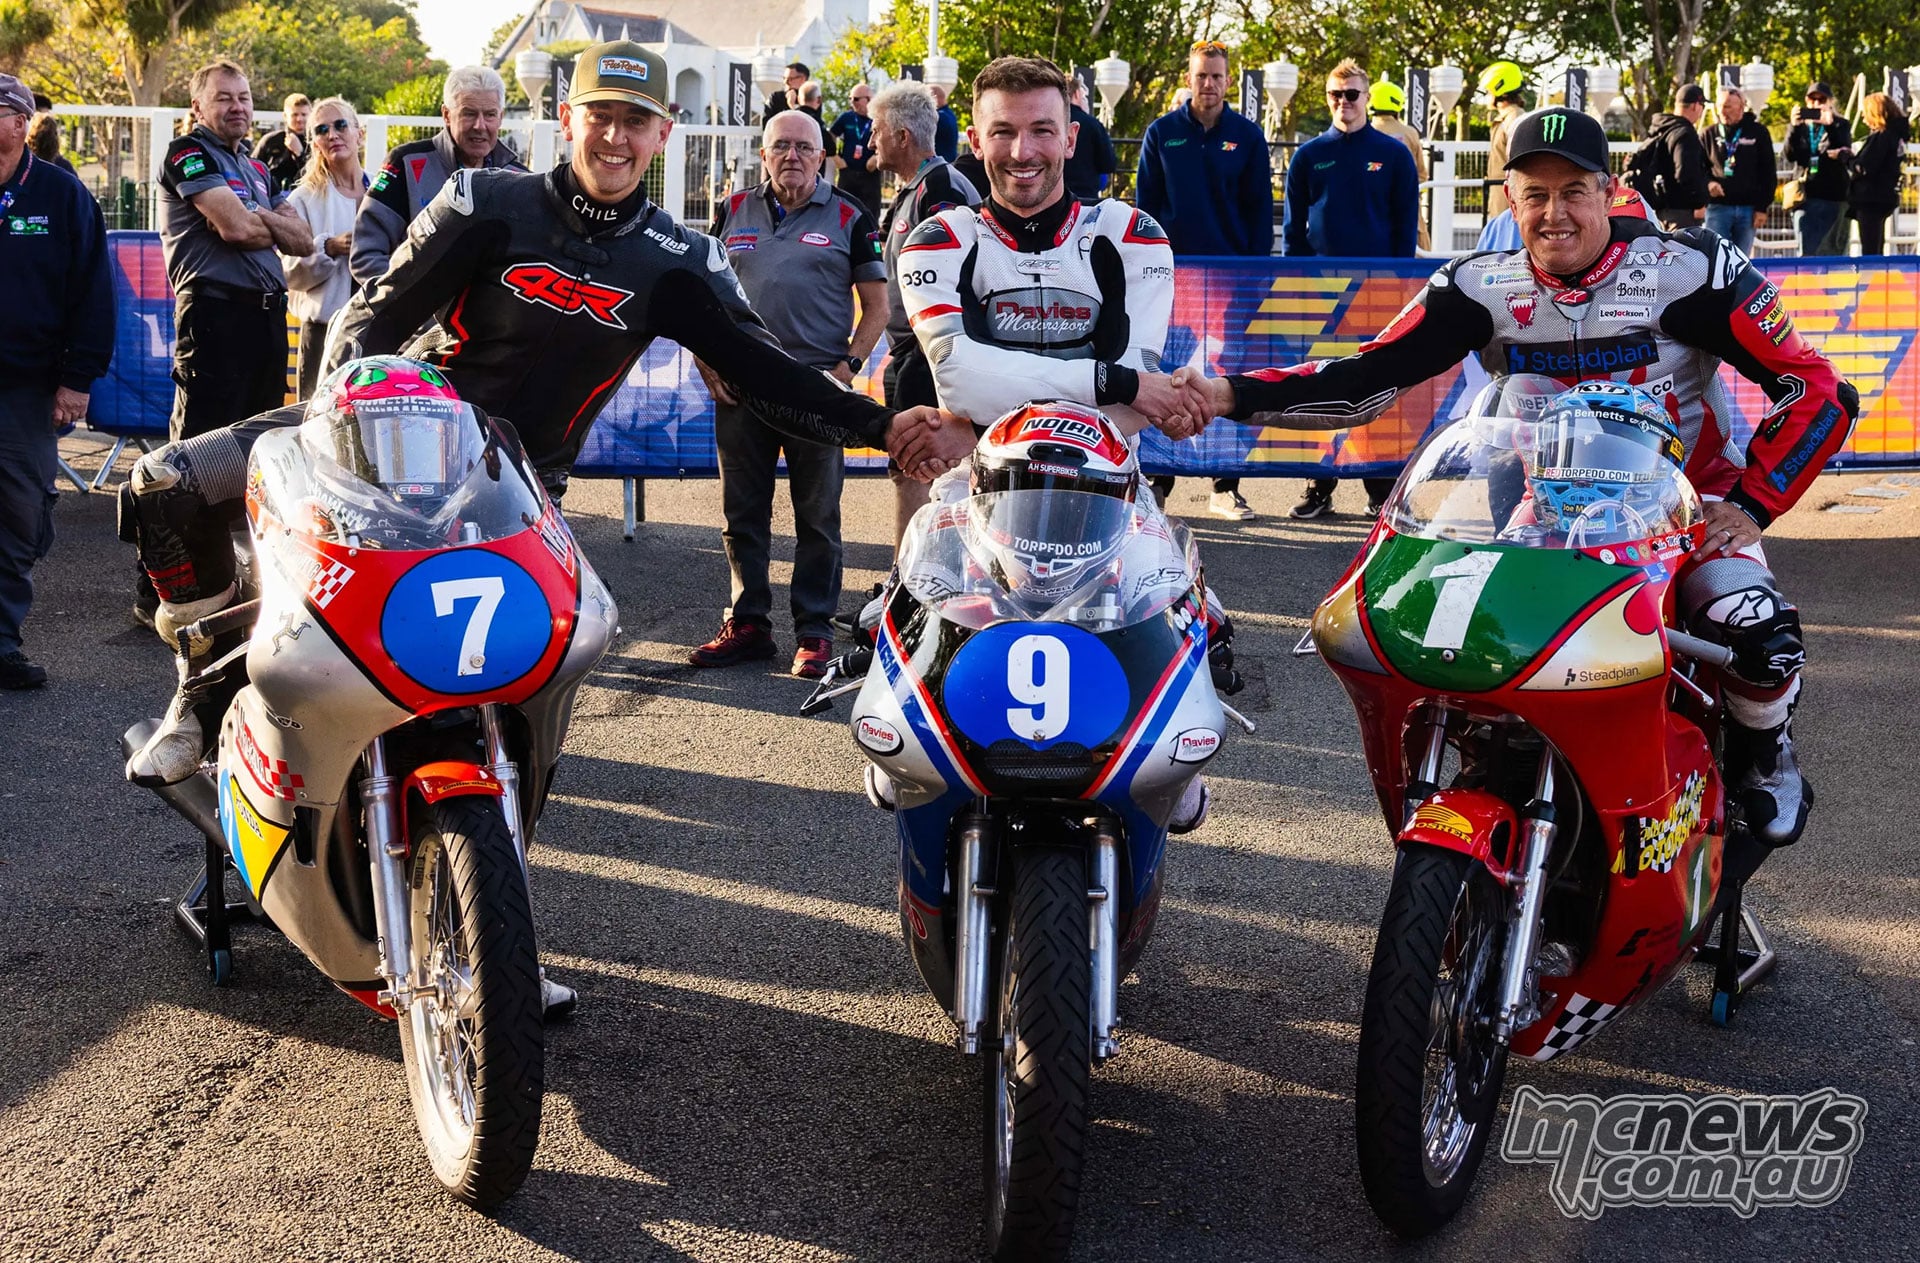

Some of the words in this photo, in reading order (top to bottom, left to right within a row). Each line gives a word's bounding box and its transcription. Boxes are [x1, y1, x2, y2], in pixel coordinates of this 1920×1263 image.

[733, 68, 746, 126] RST
[1412, 74, 1425, 133] RST
[643, 227, 691, 256] NOLAN
[1018, 258, 1061, 268] RST
[1586, 246, 1622, 283] RACING
[995, 311, 1091, 334] Motorsport
[996, 302, 1092, 320] Davies
[1531, 342, 1657, 373] Steadplan.
[1574, 408, 1625, 422] Bennetts
[1022, 418, 1103, 448] NOLAN
[1784, 408, 1840, 475] Steadplan.
[1039, 464, 1079, 477] SUPERBIKES
[1422, 551, 1504, 649] 1
[431, 576, 505, 677] 7
[1006, 634, 1071, 742] 9
[1580, 667, 1640, 682] Steadplan.
[862, 722, 894, 742] Davies
[1182, 736, 1216, 747] Davies
[1690, 847, 1705, 932] 1
